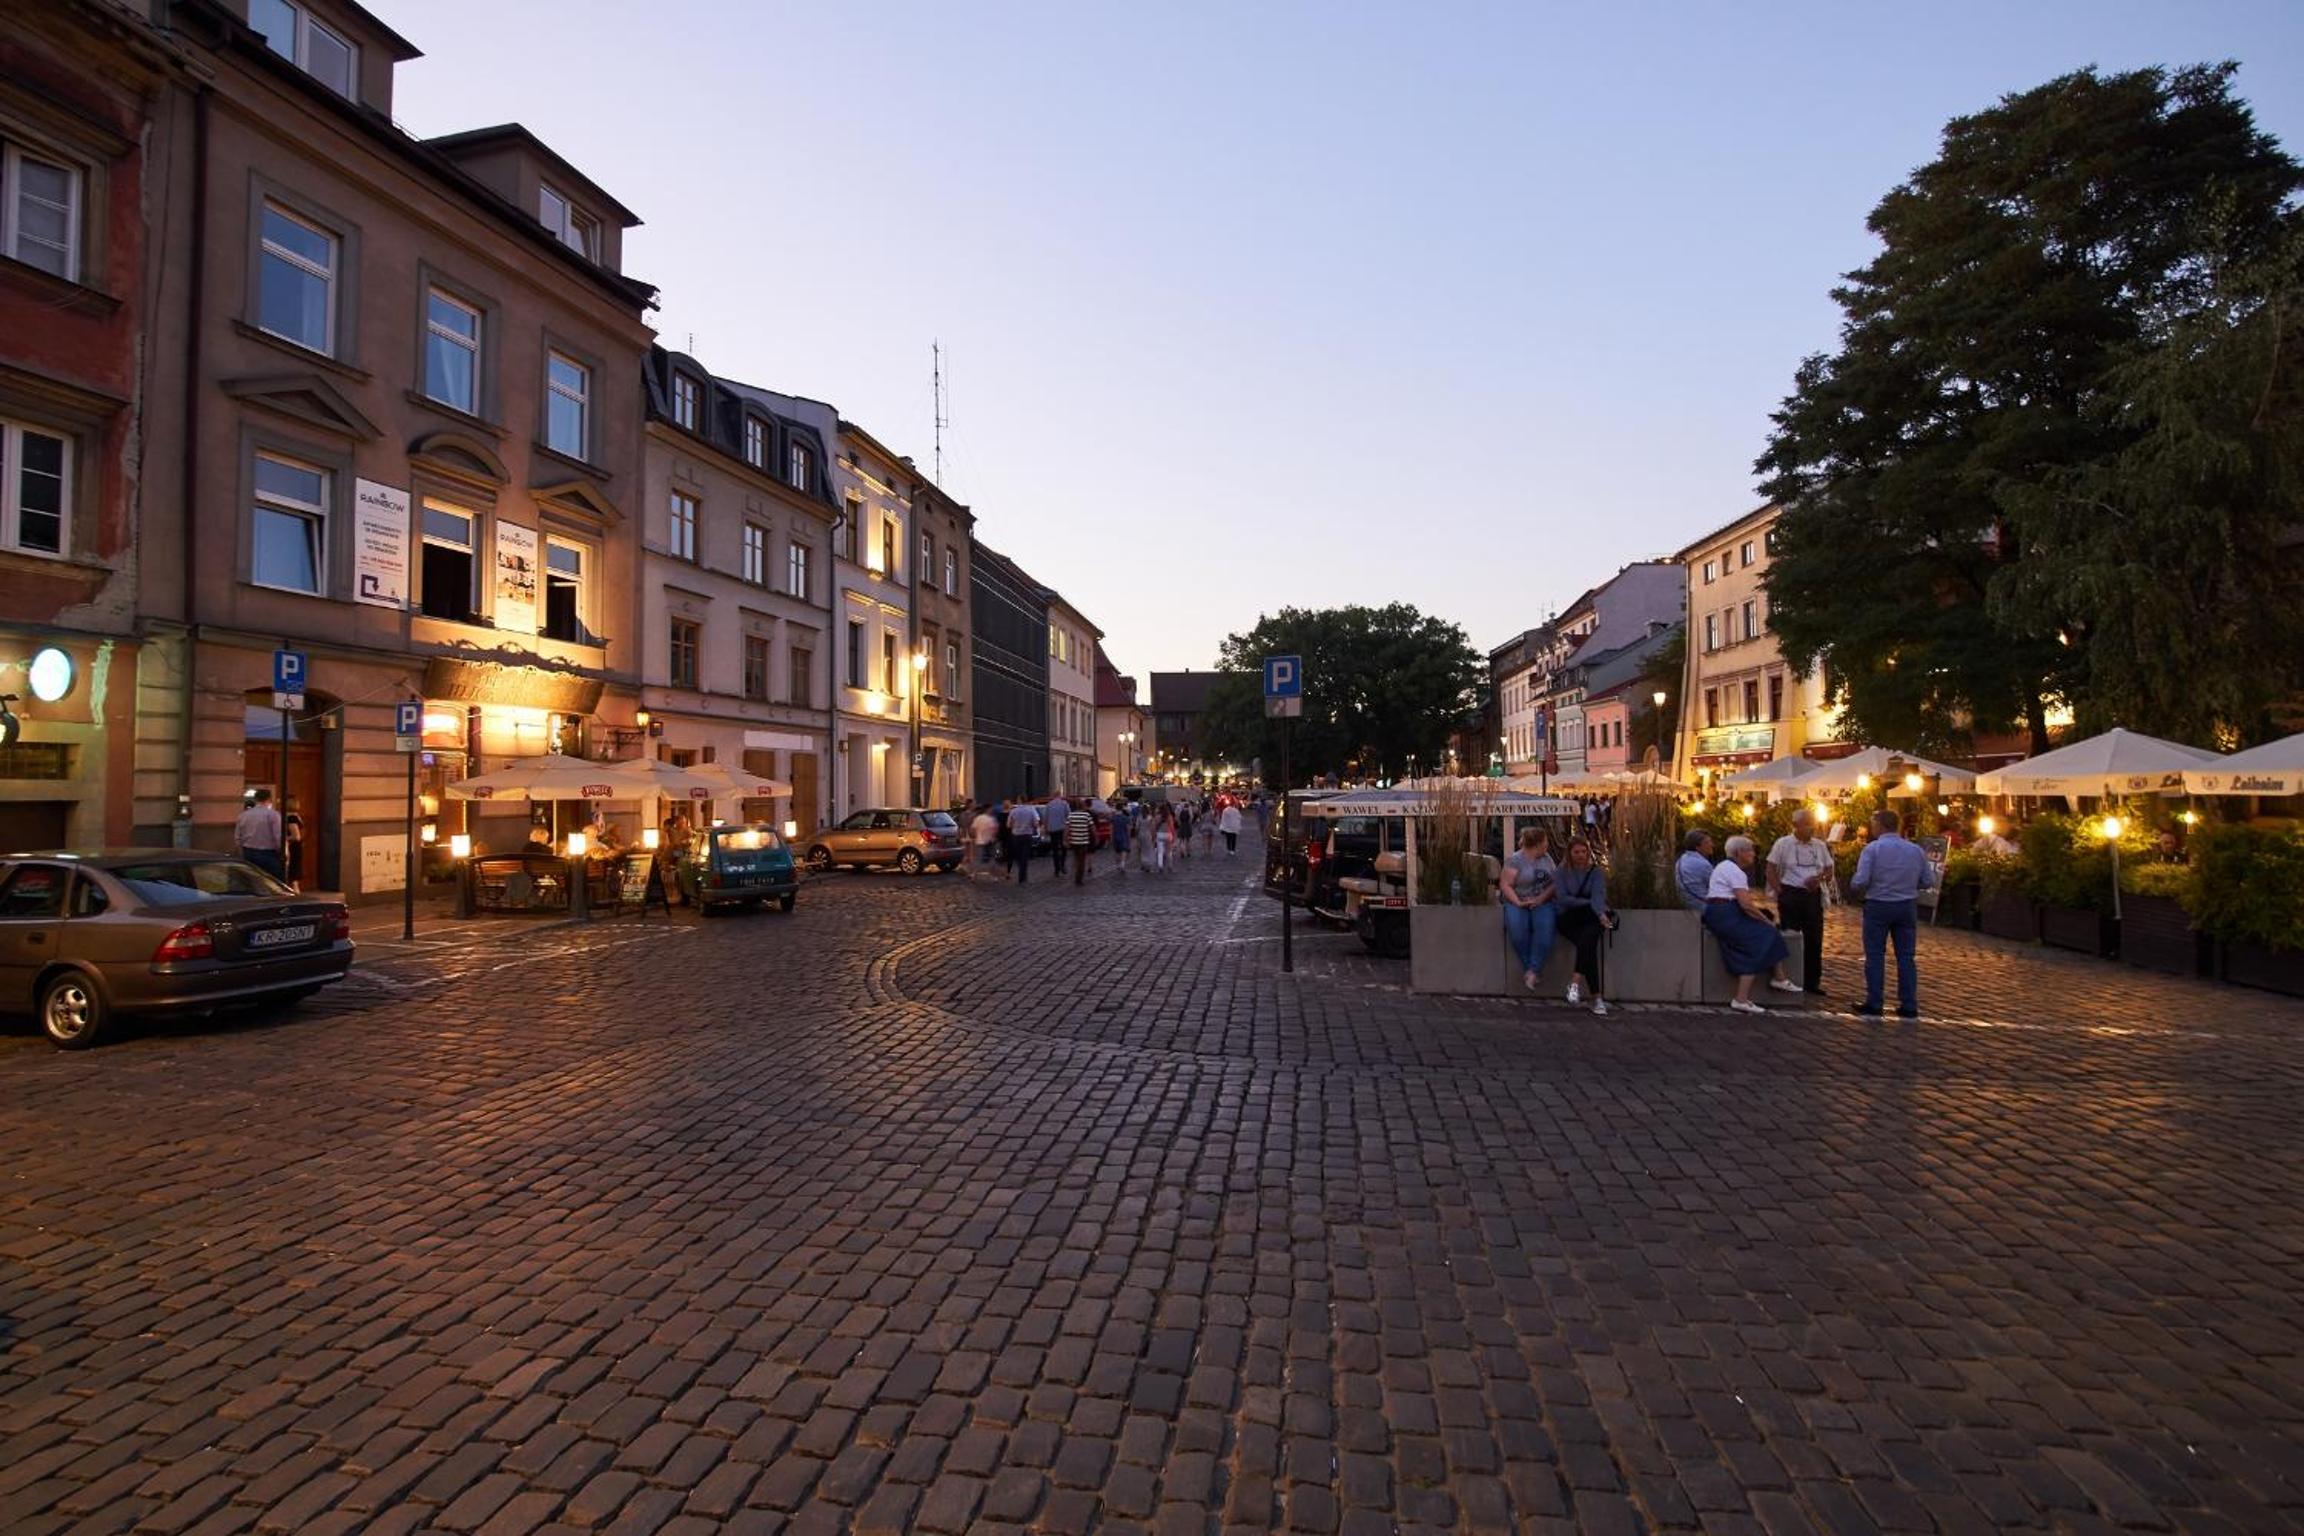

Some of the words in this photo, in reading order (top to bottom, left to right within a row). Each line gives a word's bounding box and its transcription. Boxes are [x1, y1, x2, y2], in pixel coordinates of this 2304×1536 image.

[360, 494, 404, 512] RAINBOW
[500, 534, 534, 548] RAINBOW
[281, 654, 299, 679] P
[1272, 661, 1292, 692] P
[402, 706, 417, 731] P
[1342, 805, 1380, 815] WAWEL
[1519, 804, 1559, 814] MIASTO
